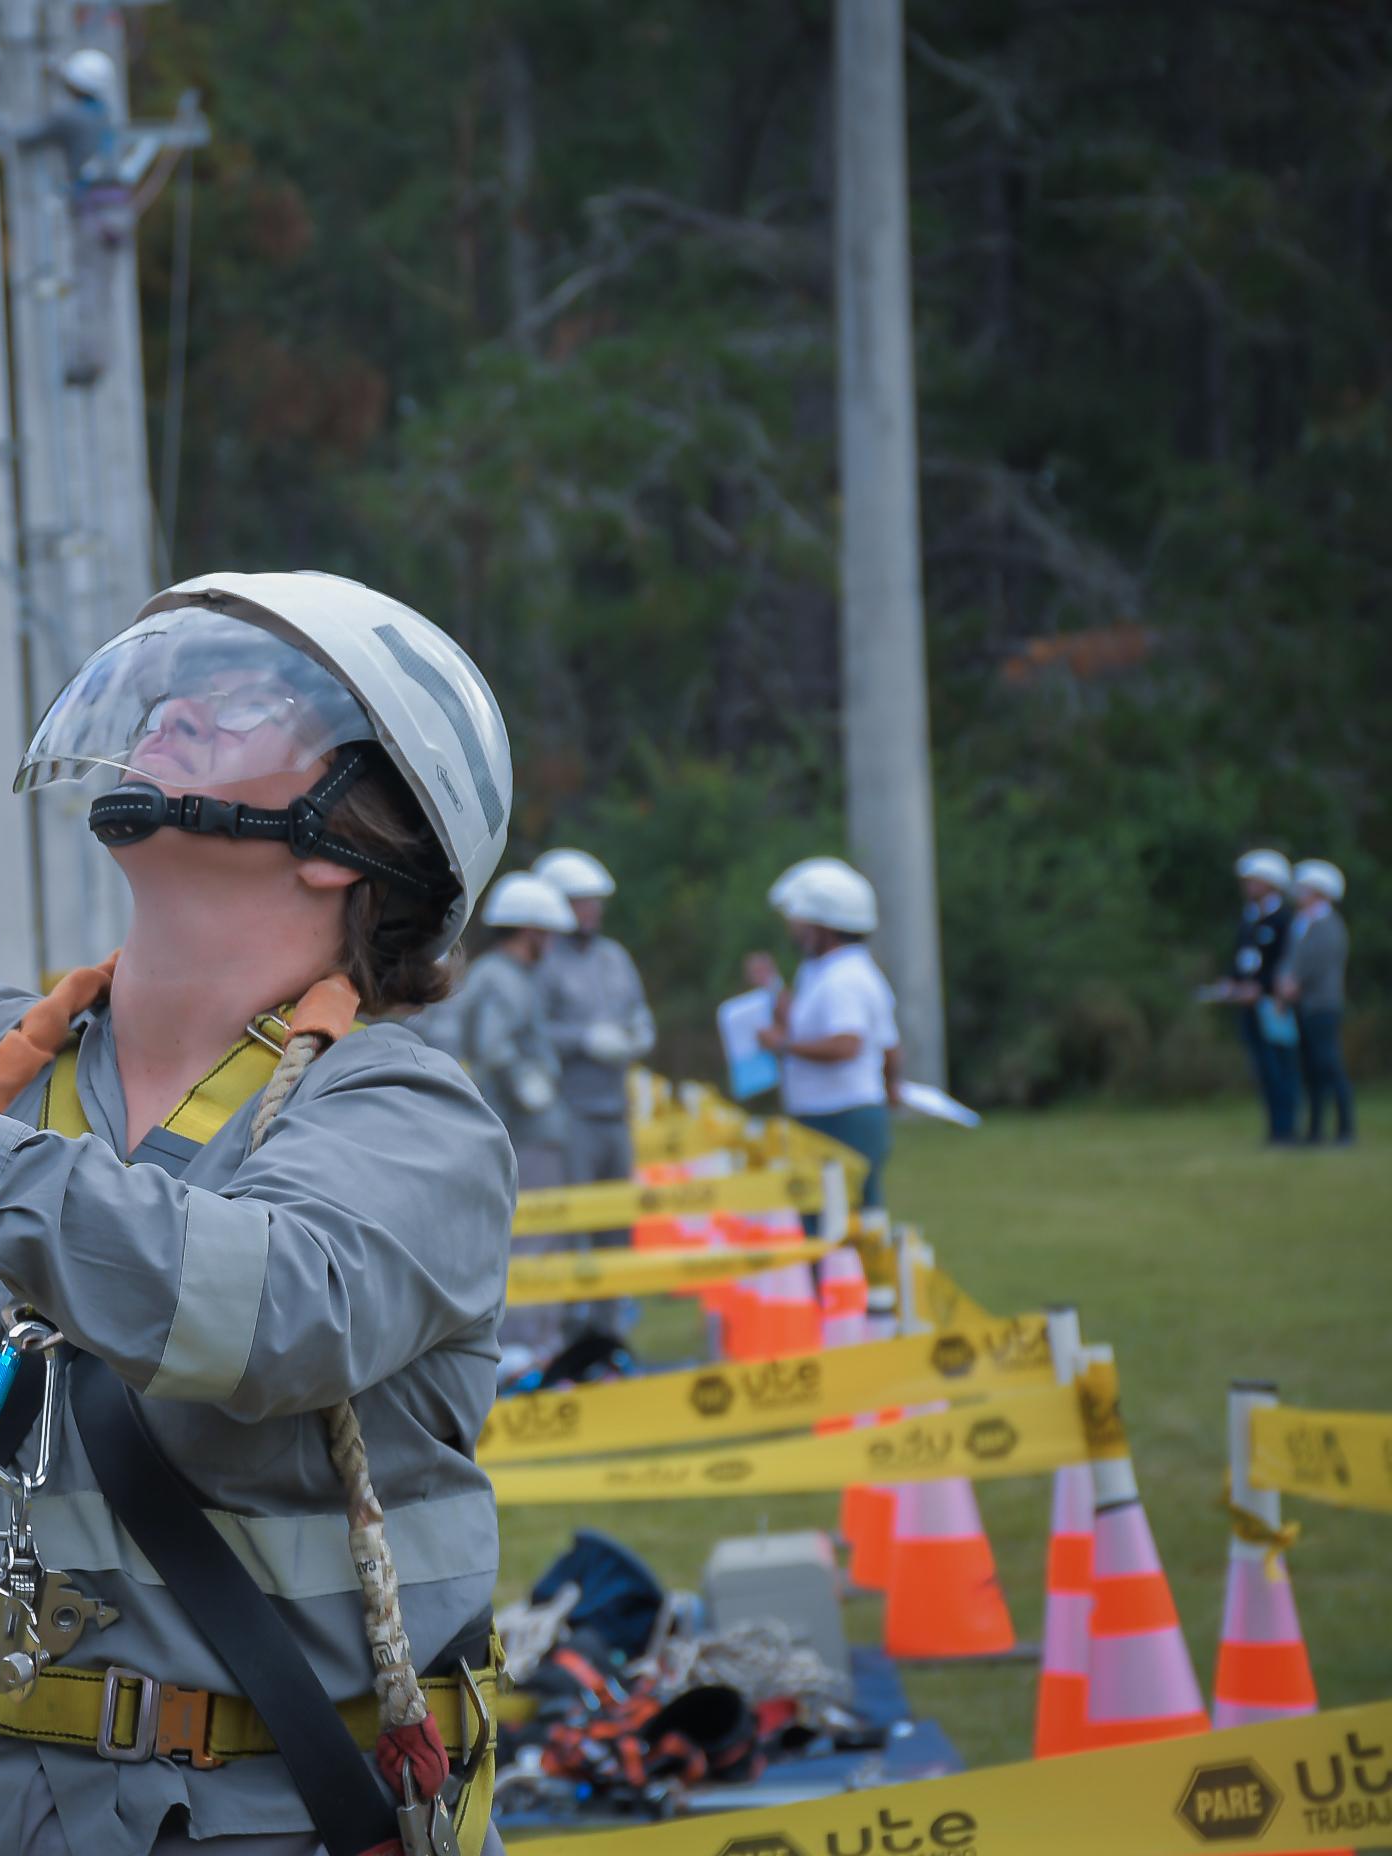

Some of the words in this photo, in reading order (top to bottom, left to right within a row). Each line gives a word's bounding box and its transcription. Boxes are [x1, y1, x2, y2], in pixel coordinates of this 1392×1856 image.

[740, 1360, 822, 1399] ute
[500, 1397, 581, 1436] ute
[1194, 1782, 1264, 1824] PARE
[825, 1807, 978, 1856] ute
